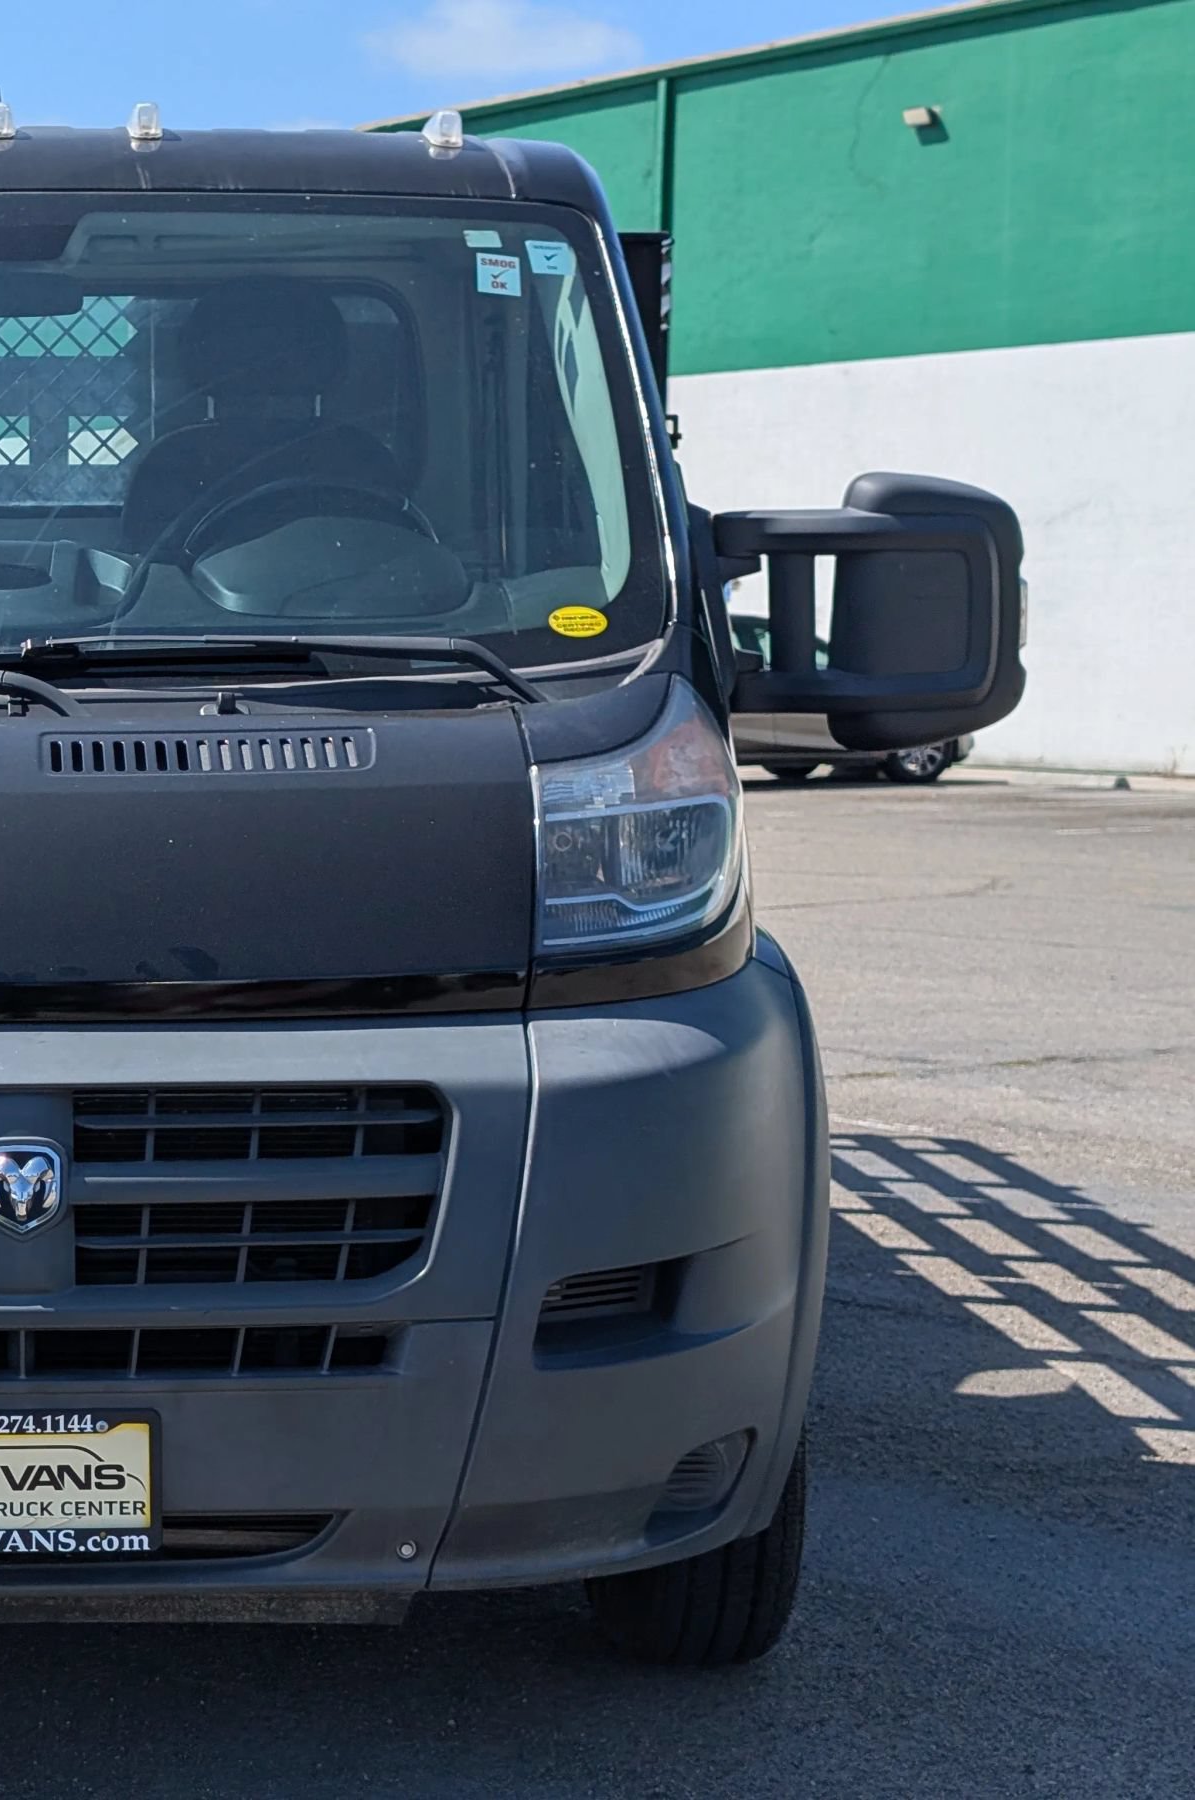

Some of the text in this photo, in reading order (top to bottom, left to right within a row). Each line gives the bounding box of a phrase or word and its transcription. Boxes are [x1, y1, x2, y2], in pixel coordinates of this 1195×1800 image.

[480, 258, 516, 268] SMOG
[492, 281, 508, 290] OK
[0, 1463, 126, 1492] VANS
[61, 1500, 147, 1517] CENTER
